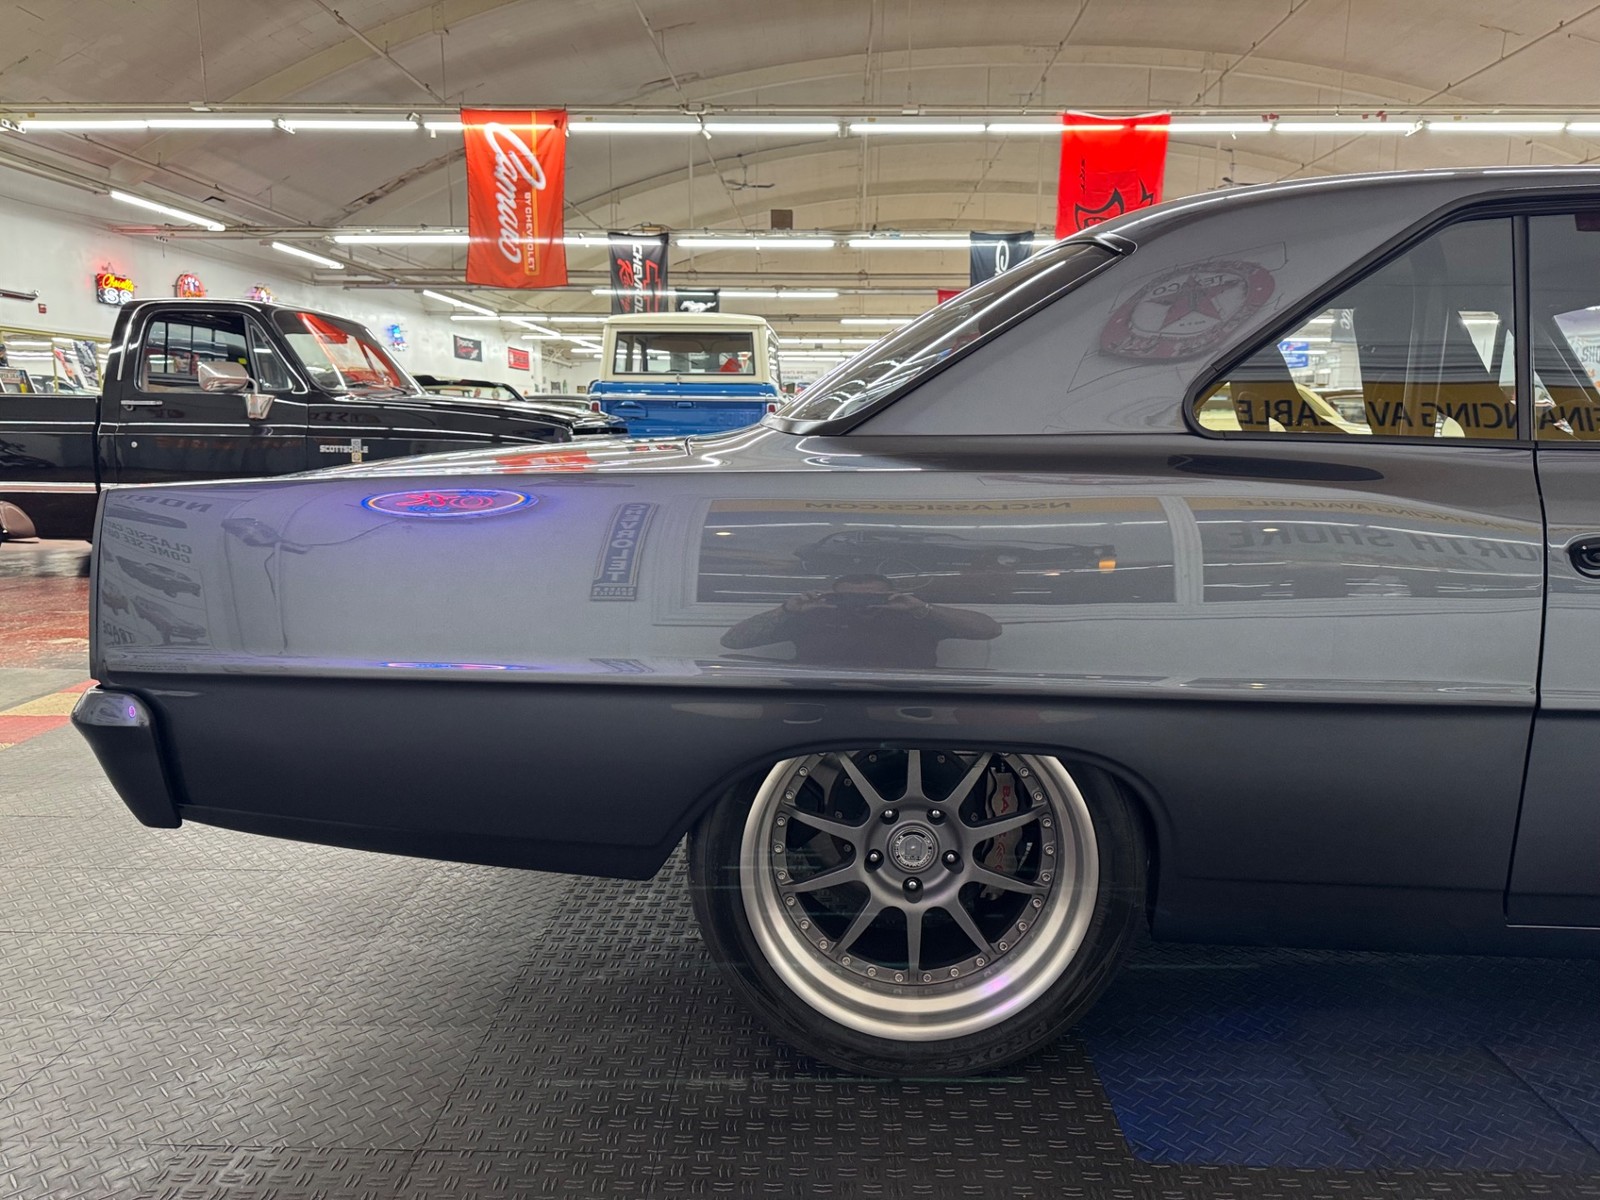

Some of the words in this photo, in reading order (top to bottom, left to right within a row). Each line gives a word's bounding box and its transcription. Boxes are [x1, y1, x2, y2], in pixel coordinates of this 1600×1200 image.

[484, 121, 547, 264] Camaro
[524, 192, 532, 205] BY
[524, 207, 535, 271] CHEVROLET
[103, 287, 133, 304] SS
[632, 243, 644, 313] CHEVROL
